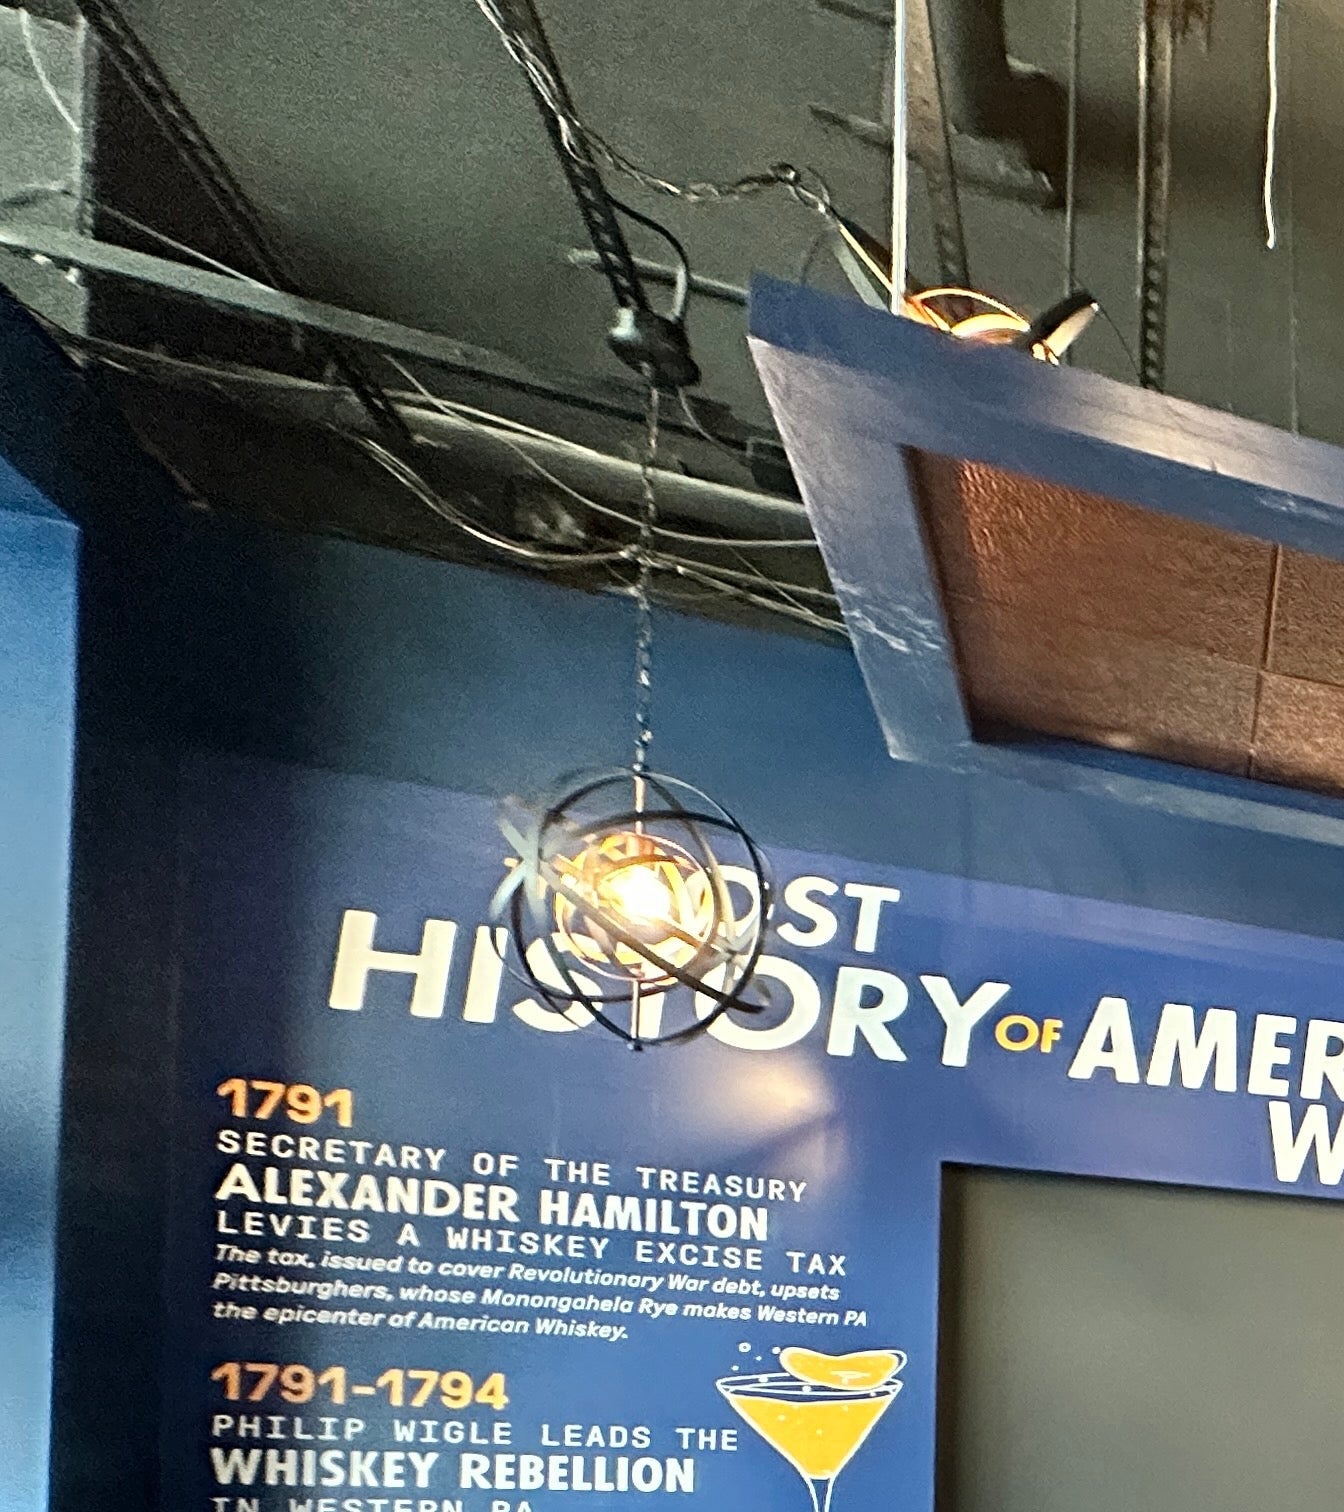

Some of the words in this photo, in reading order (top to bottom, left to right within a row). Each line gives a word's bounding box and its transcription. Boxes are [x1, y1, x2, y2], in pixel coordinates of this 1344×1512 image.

[994, 1013, 1064, 1054] OF
[217, 1078, 354, 1128] 1791
[217, 1129, 446, 1171] SECRETARY
[473, 1152, 519, 1177] OF
[543, 1158, 610, 1186] THE
[635, 1166, 811, 1203] TREASURY
[215, 1165, 520, 1222] ALEXANDER
[540, 1189, 768, 1241] HAMILTON
[218, 1210, 370, 1243] LEVIES
[396, 1222, 420, 1247] A
[446, 1226, 609, 1259] WHISKEY
[635, 1240, 762, 1270] EXCISE
[785, 1251, 846, 1276] TAX
[212, 1362, 510, 1410] 1791-1794
[212, 1415, 365, 1441] PHILIP
[393, 1419, 512, 1445] WIGLE
[541, 1423, 650, 1449] LEADS
[674, 1427, 737, 1451] THE
[211, 1447, 439, 1488] WHISKEY
[459, 1452, 694, 1493] REBELLION
